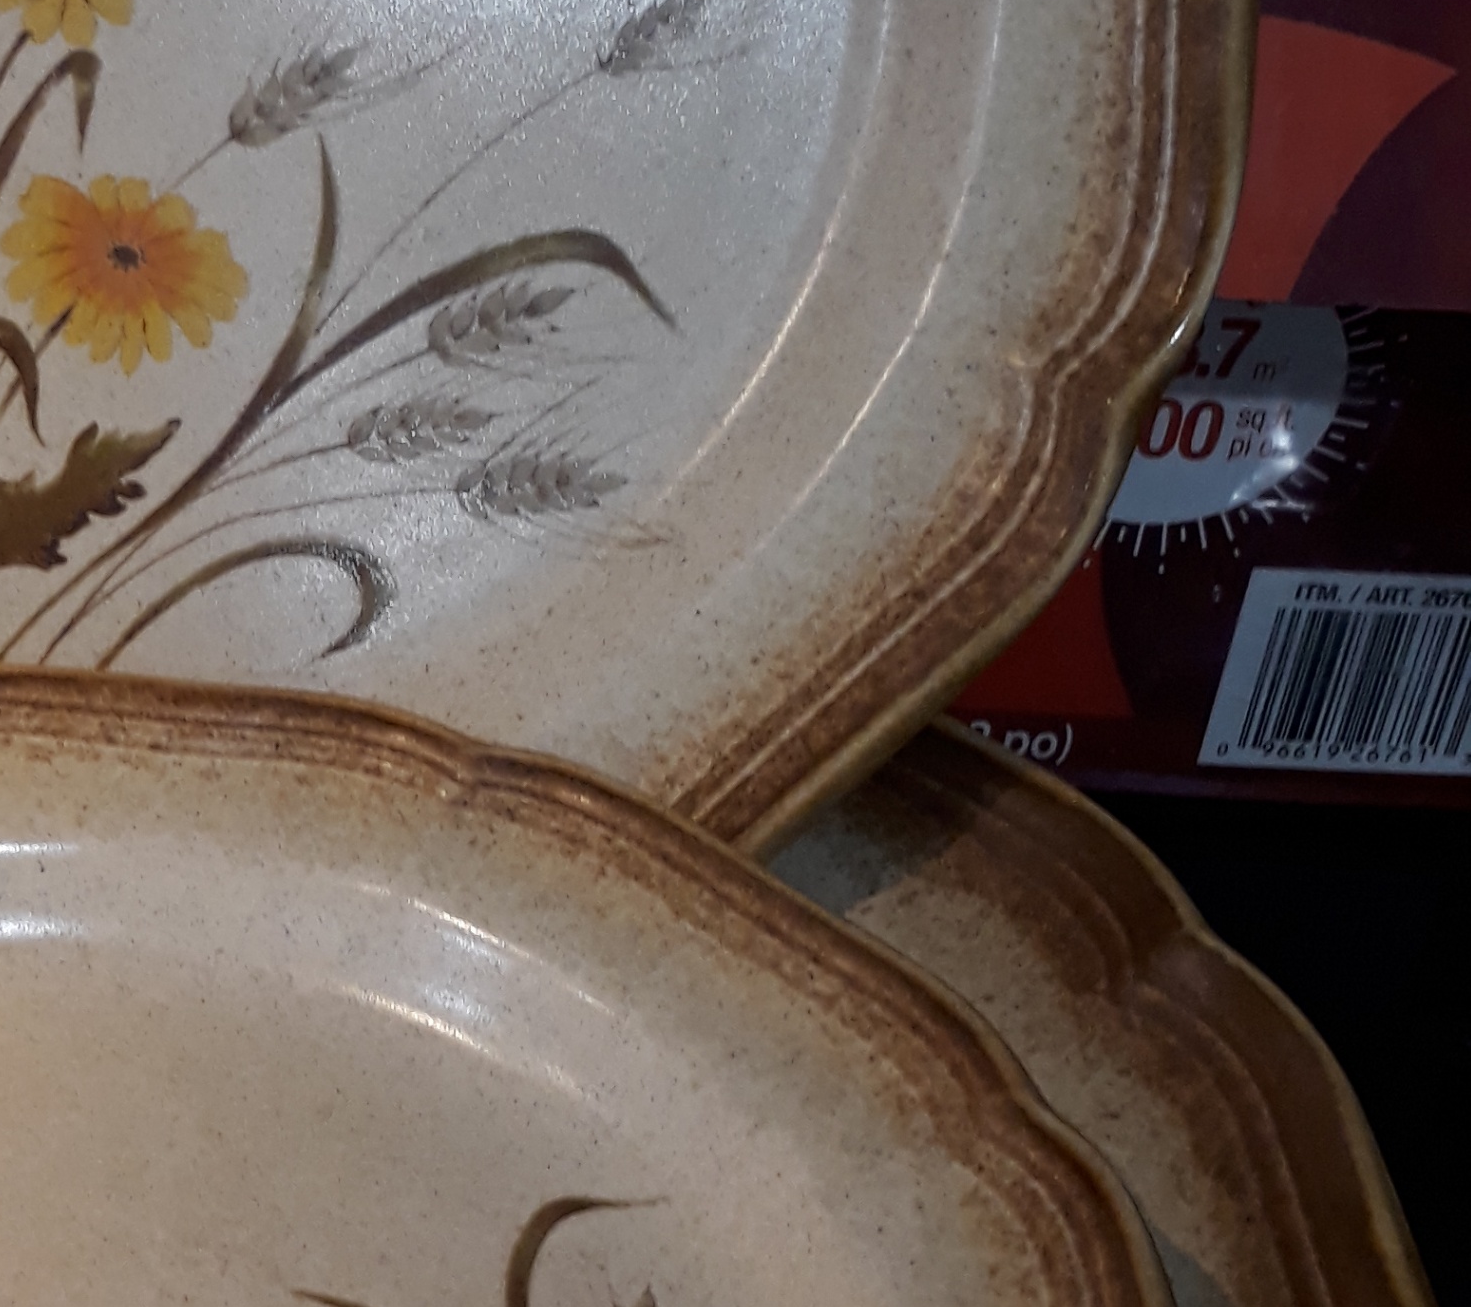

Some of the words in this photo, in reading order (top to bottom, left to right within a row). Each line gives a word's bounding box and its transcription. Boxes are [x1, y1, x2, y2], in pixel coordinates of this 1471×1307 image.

[1295, 581, 1341, 604] ITM.
[1348, 583, 1362, 604] /
[1365, 585, 1412, 607] ART.
[1217, 741, 1229, 758] 0
